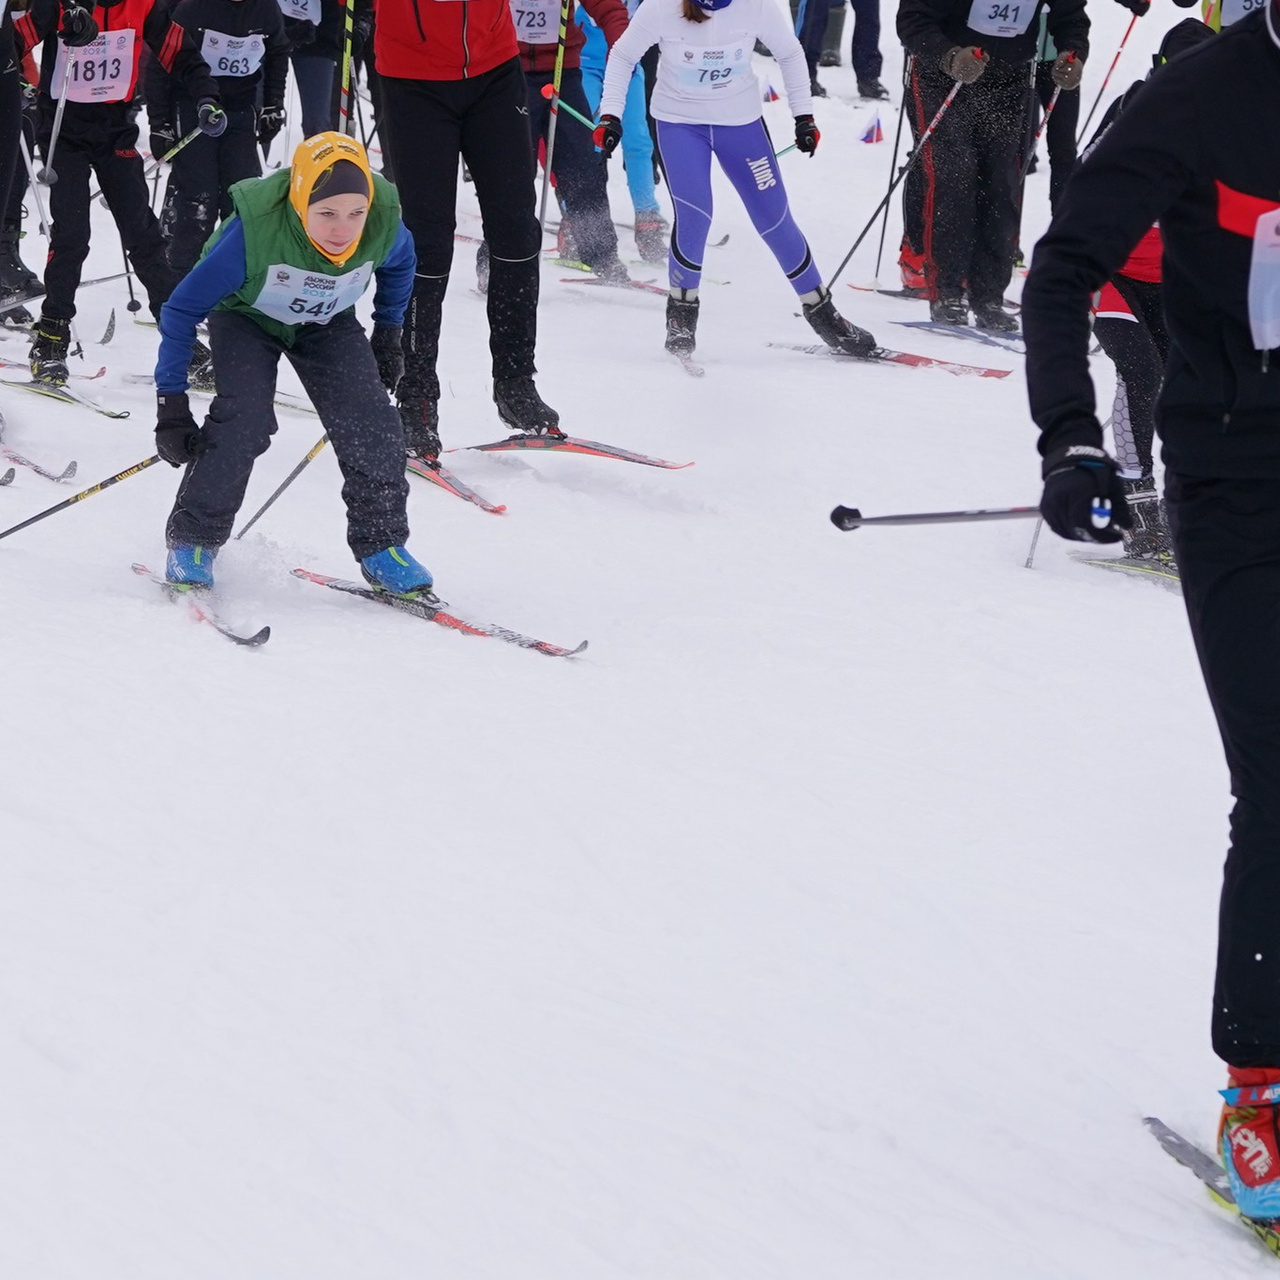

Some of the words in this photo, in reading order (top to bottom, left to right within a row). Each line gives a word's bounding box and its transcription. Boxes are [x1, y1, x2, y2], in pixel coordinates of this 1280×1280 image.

[515, 9, 546, 28] 723
[988, 3, 1020, 23] 341
[83, 48, 107, 56] 2024
[72, 58, 121, 82] 1813
[218, 57, 250, 75] 663
[748, 156, 776, 190] SWIX
[303, 281, 334, 291] РОССИИ
[304, 275, 336, 285] ЛЫЖНЯ
[302, 288, 334, 298] 2024
